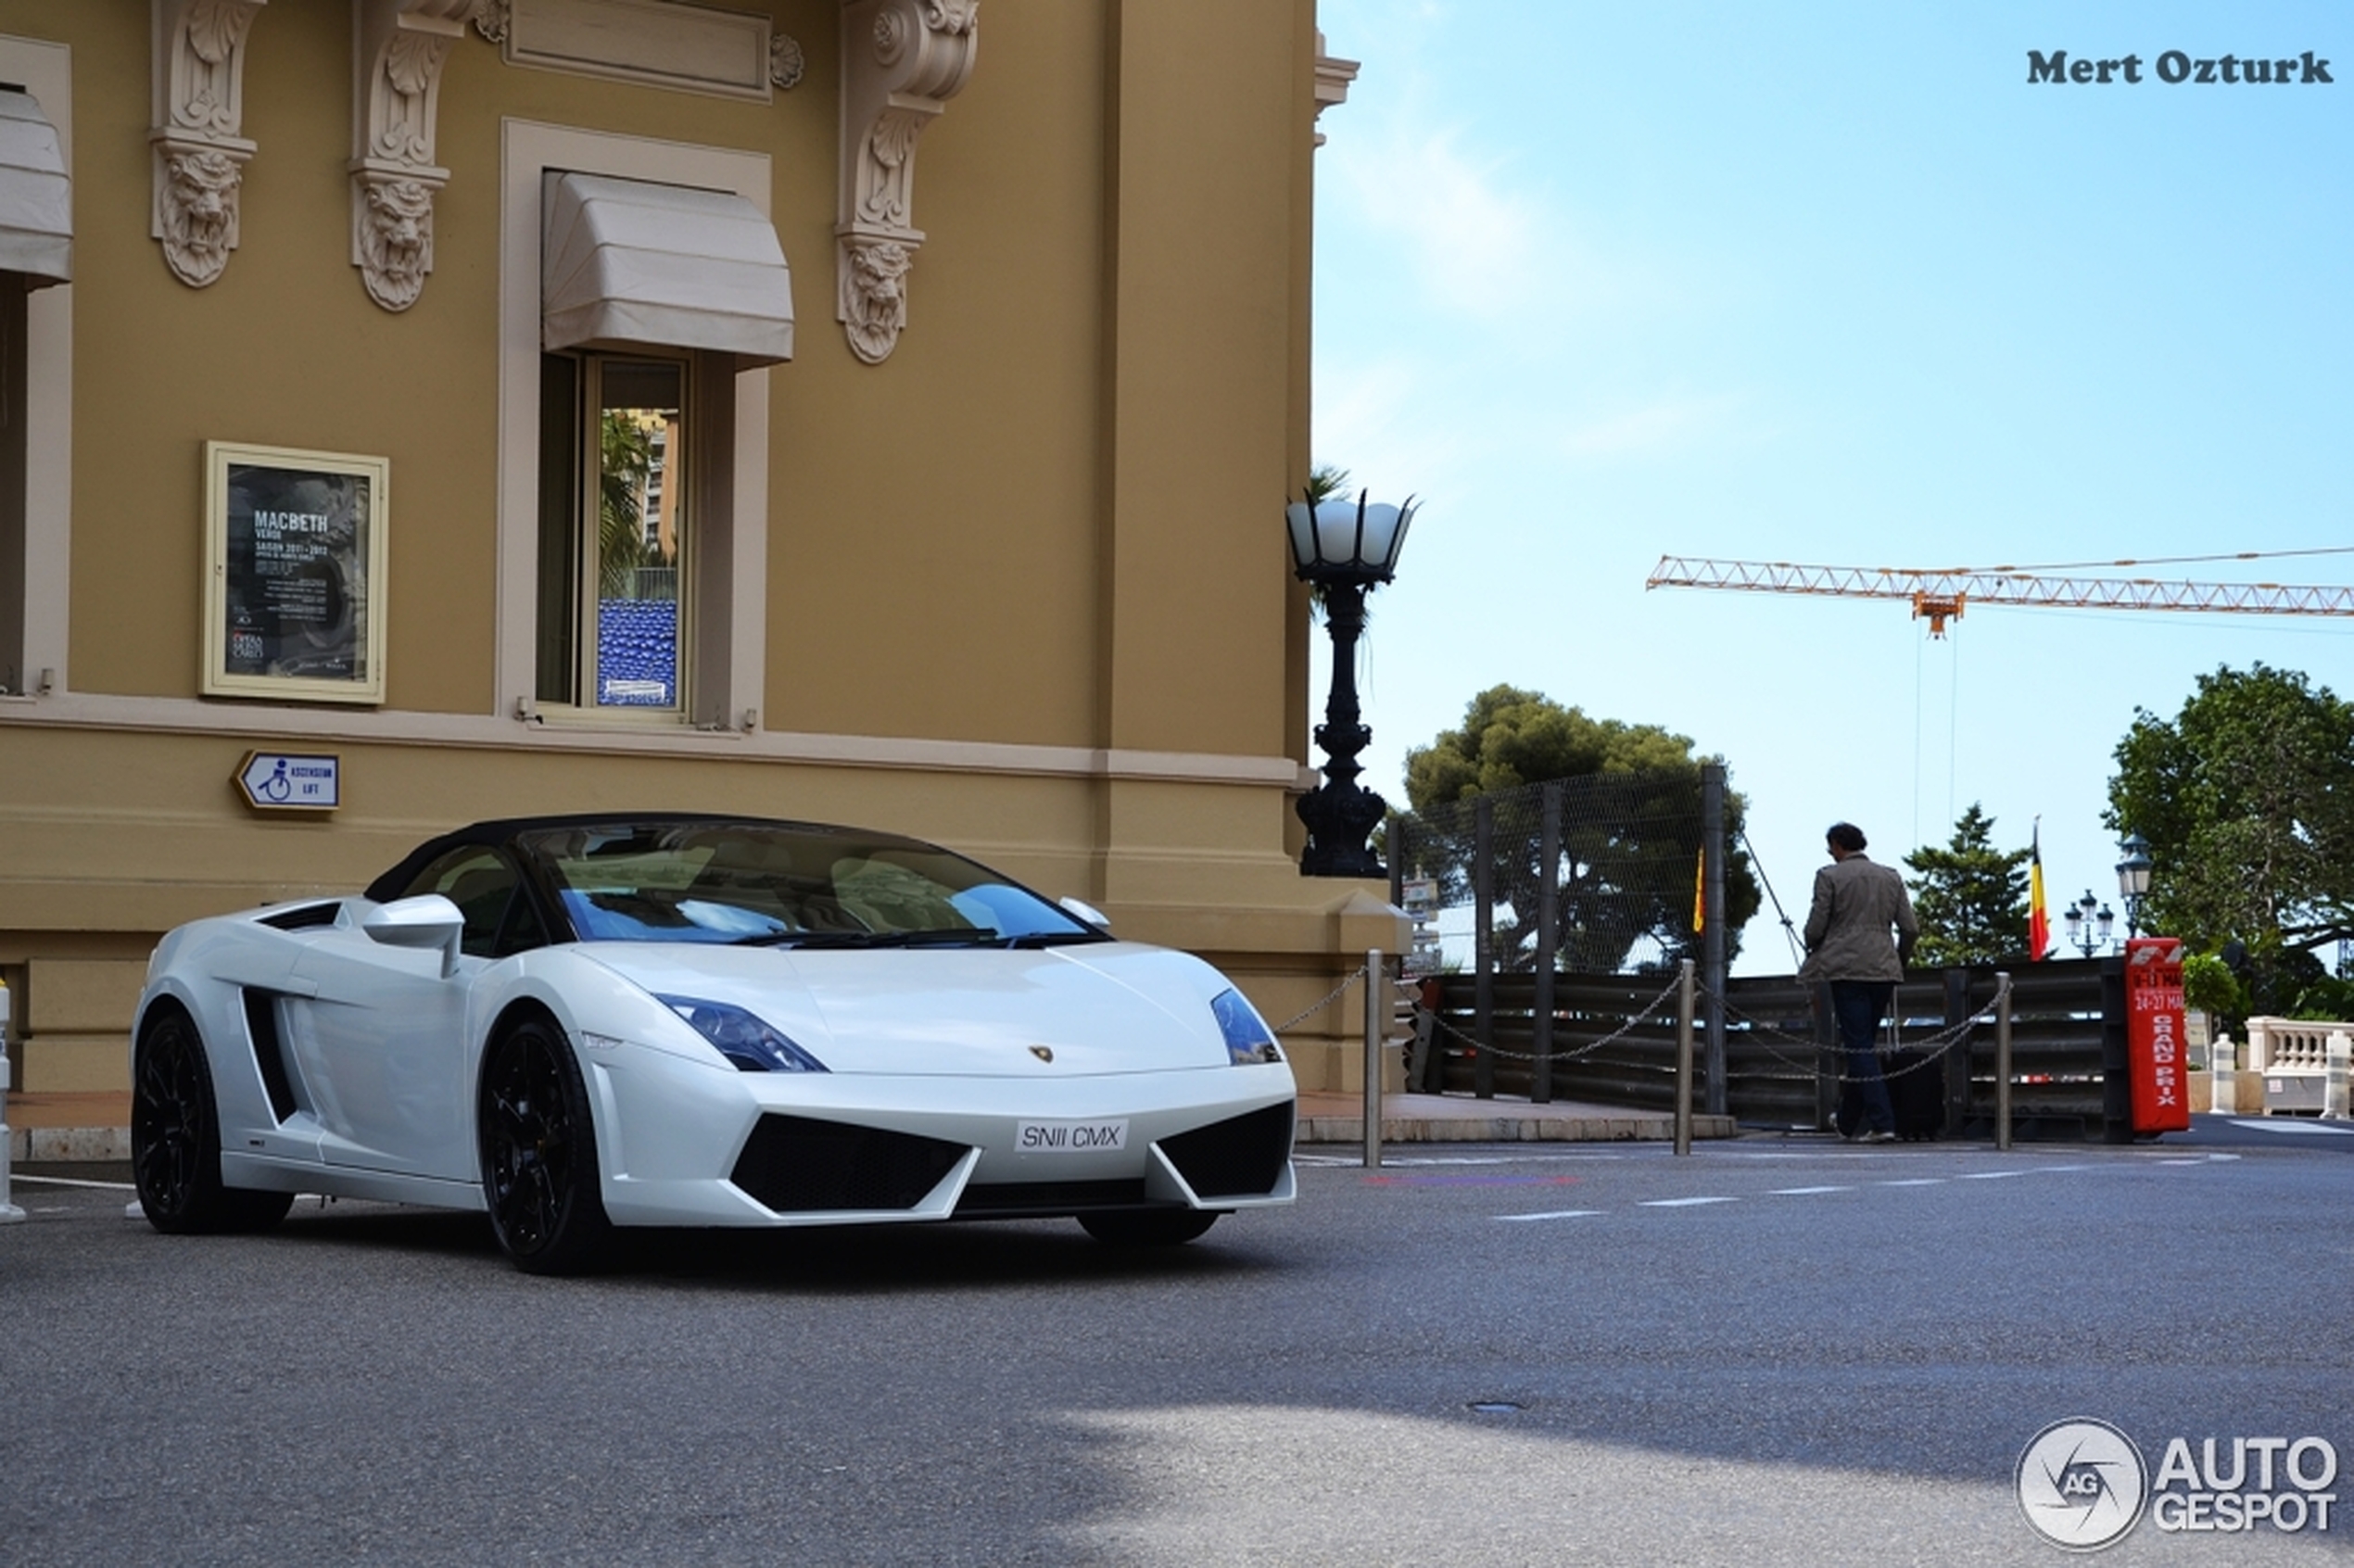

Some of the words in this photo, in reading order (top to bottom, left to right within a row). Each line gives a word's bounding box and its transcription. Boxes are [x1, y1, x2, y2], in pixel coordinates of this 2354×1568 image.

[255, 511, 328, 533] MACBETH
[291, 767, 332, 778] ASCENSEUR
[302, 783, 319, 794] LIFT
[2153, 1014, 2175, 1064] GRAND
[2156, 1067, 2176, 1106] PRIX
[1022, 1126, 1067, 1147] SN11
[1072, 1126, 1120, 1147] CMX
